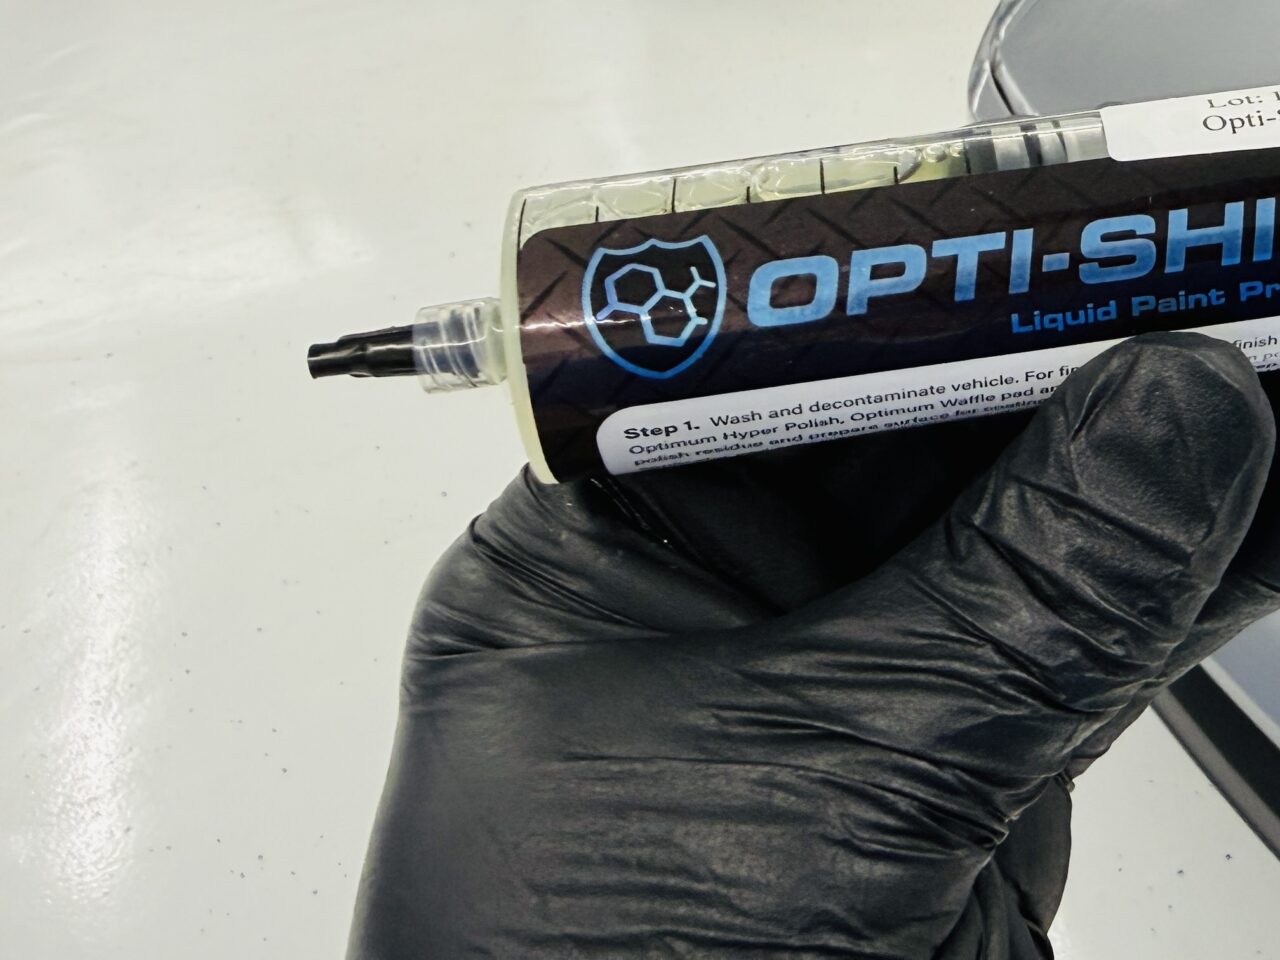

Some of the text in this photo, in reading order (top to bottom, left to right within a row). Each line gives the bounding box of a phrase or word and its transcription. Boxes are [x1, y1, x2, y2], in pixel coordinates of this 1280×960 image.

[1207, 95, 1263, 108] Lot:
[1010, 300, 1117, 334] Liquid
[1131, 286, 1226, 317] Paint
[623, 424, 679, 442] Step
[683, 420, 700, 431] 1.
[709, 410, 762, 427] Wash
[768, 403, 803, 419] and
[809, 384, 946, 413] decontaminate
[951, 374, 1019, 392] vehicle.
[1025, 368, 1054, 382] For
[629, 434, 718, 455] Optimum
[723, 426, 779, 442] Hyper
[850, 403, 935, 422] Optimum
[940, 394, 996, 409] Waffle
[1001, 387, 1034, 401] pad
